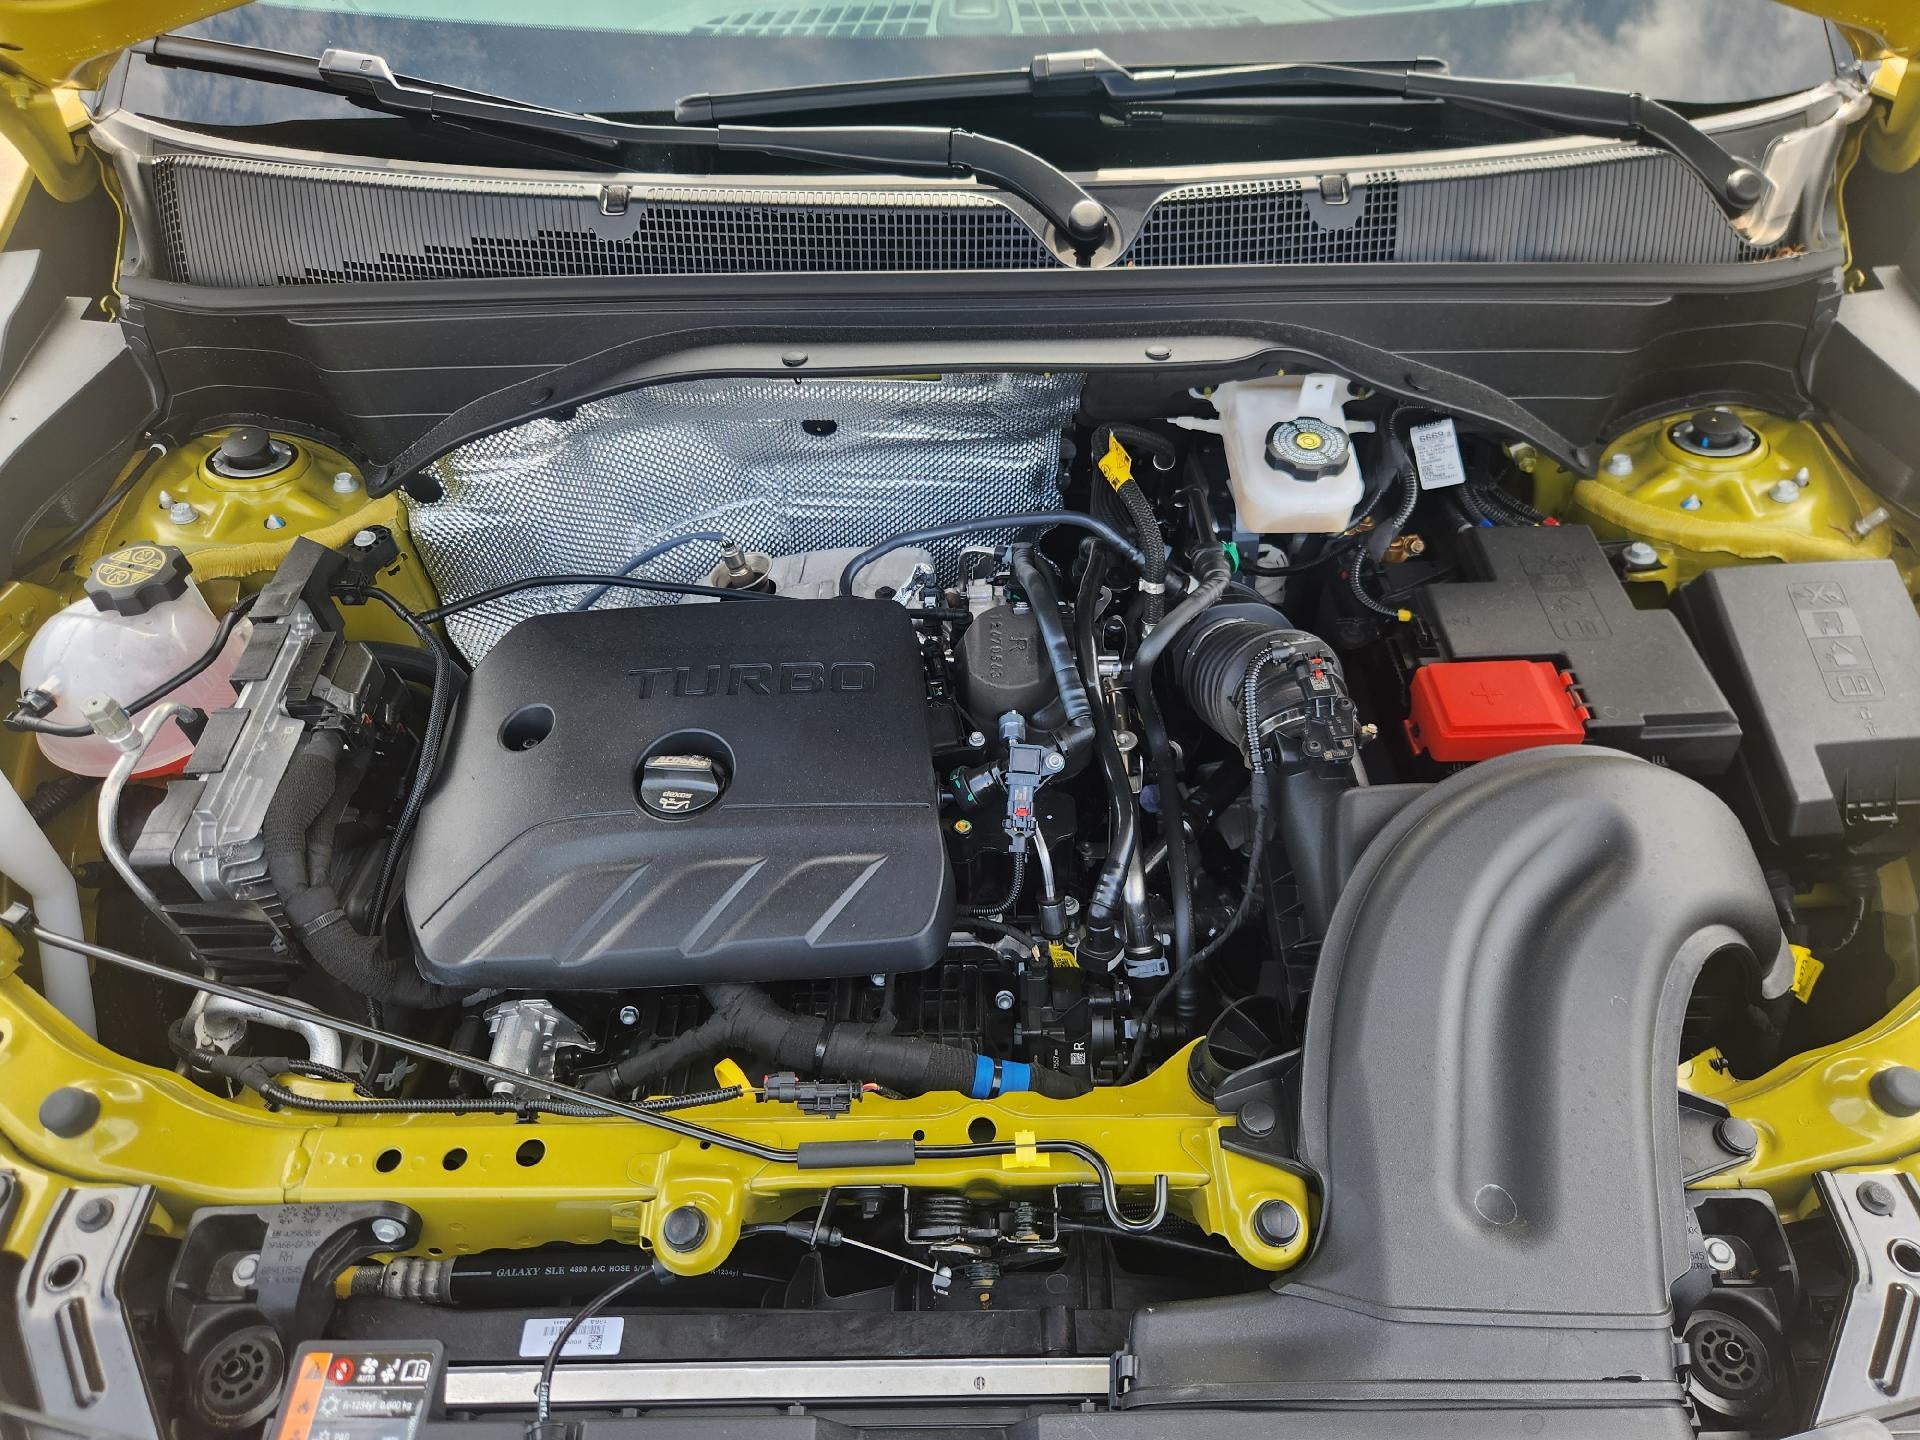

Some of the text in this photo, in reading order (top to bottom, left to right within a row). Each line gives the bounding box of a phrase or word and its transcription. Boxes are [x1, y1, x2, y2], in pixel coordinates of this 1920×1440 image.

[628, 661, 879, 700] TURBO
[1073, 1042, 1085, 1050] R
[496, 1267, 540, 1277] GALAXY
[544, 1266, 565, 1275] SLE
[590, 1265, 606, 1273] A/C
[357, 1374, 376, 1382] AUTO
